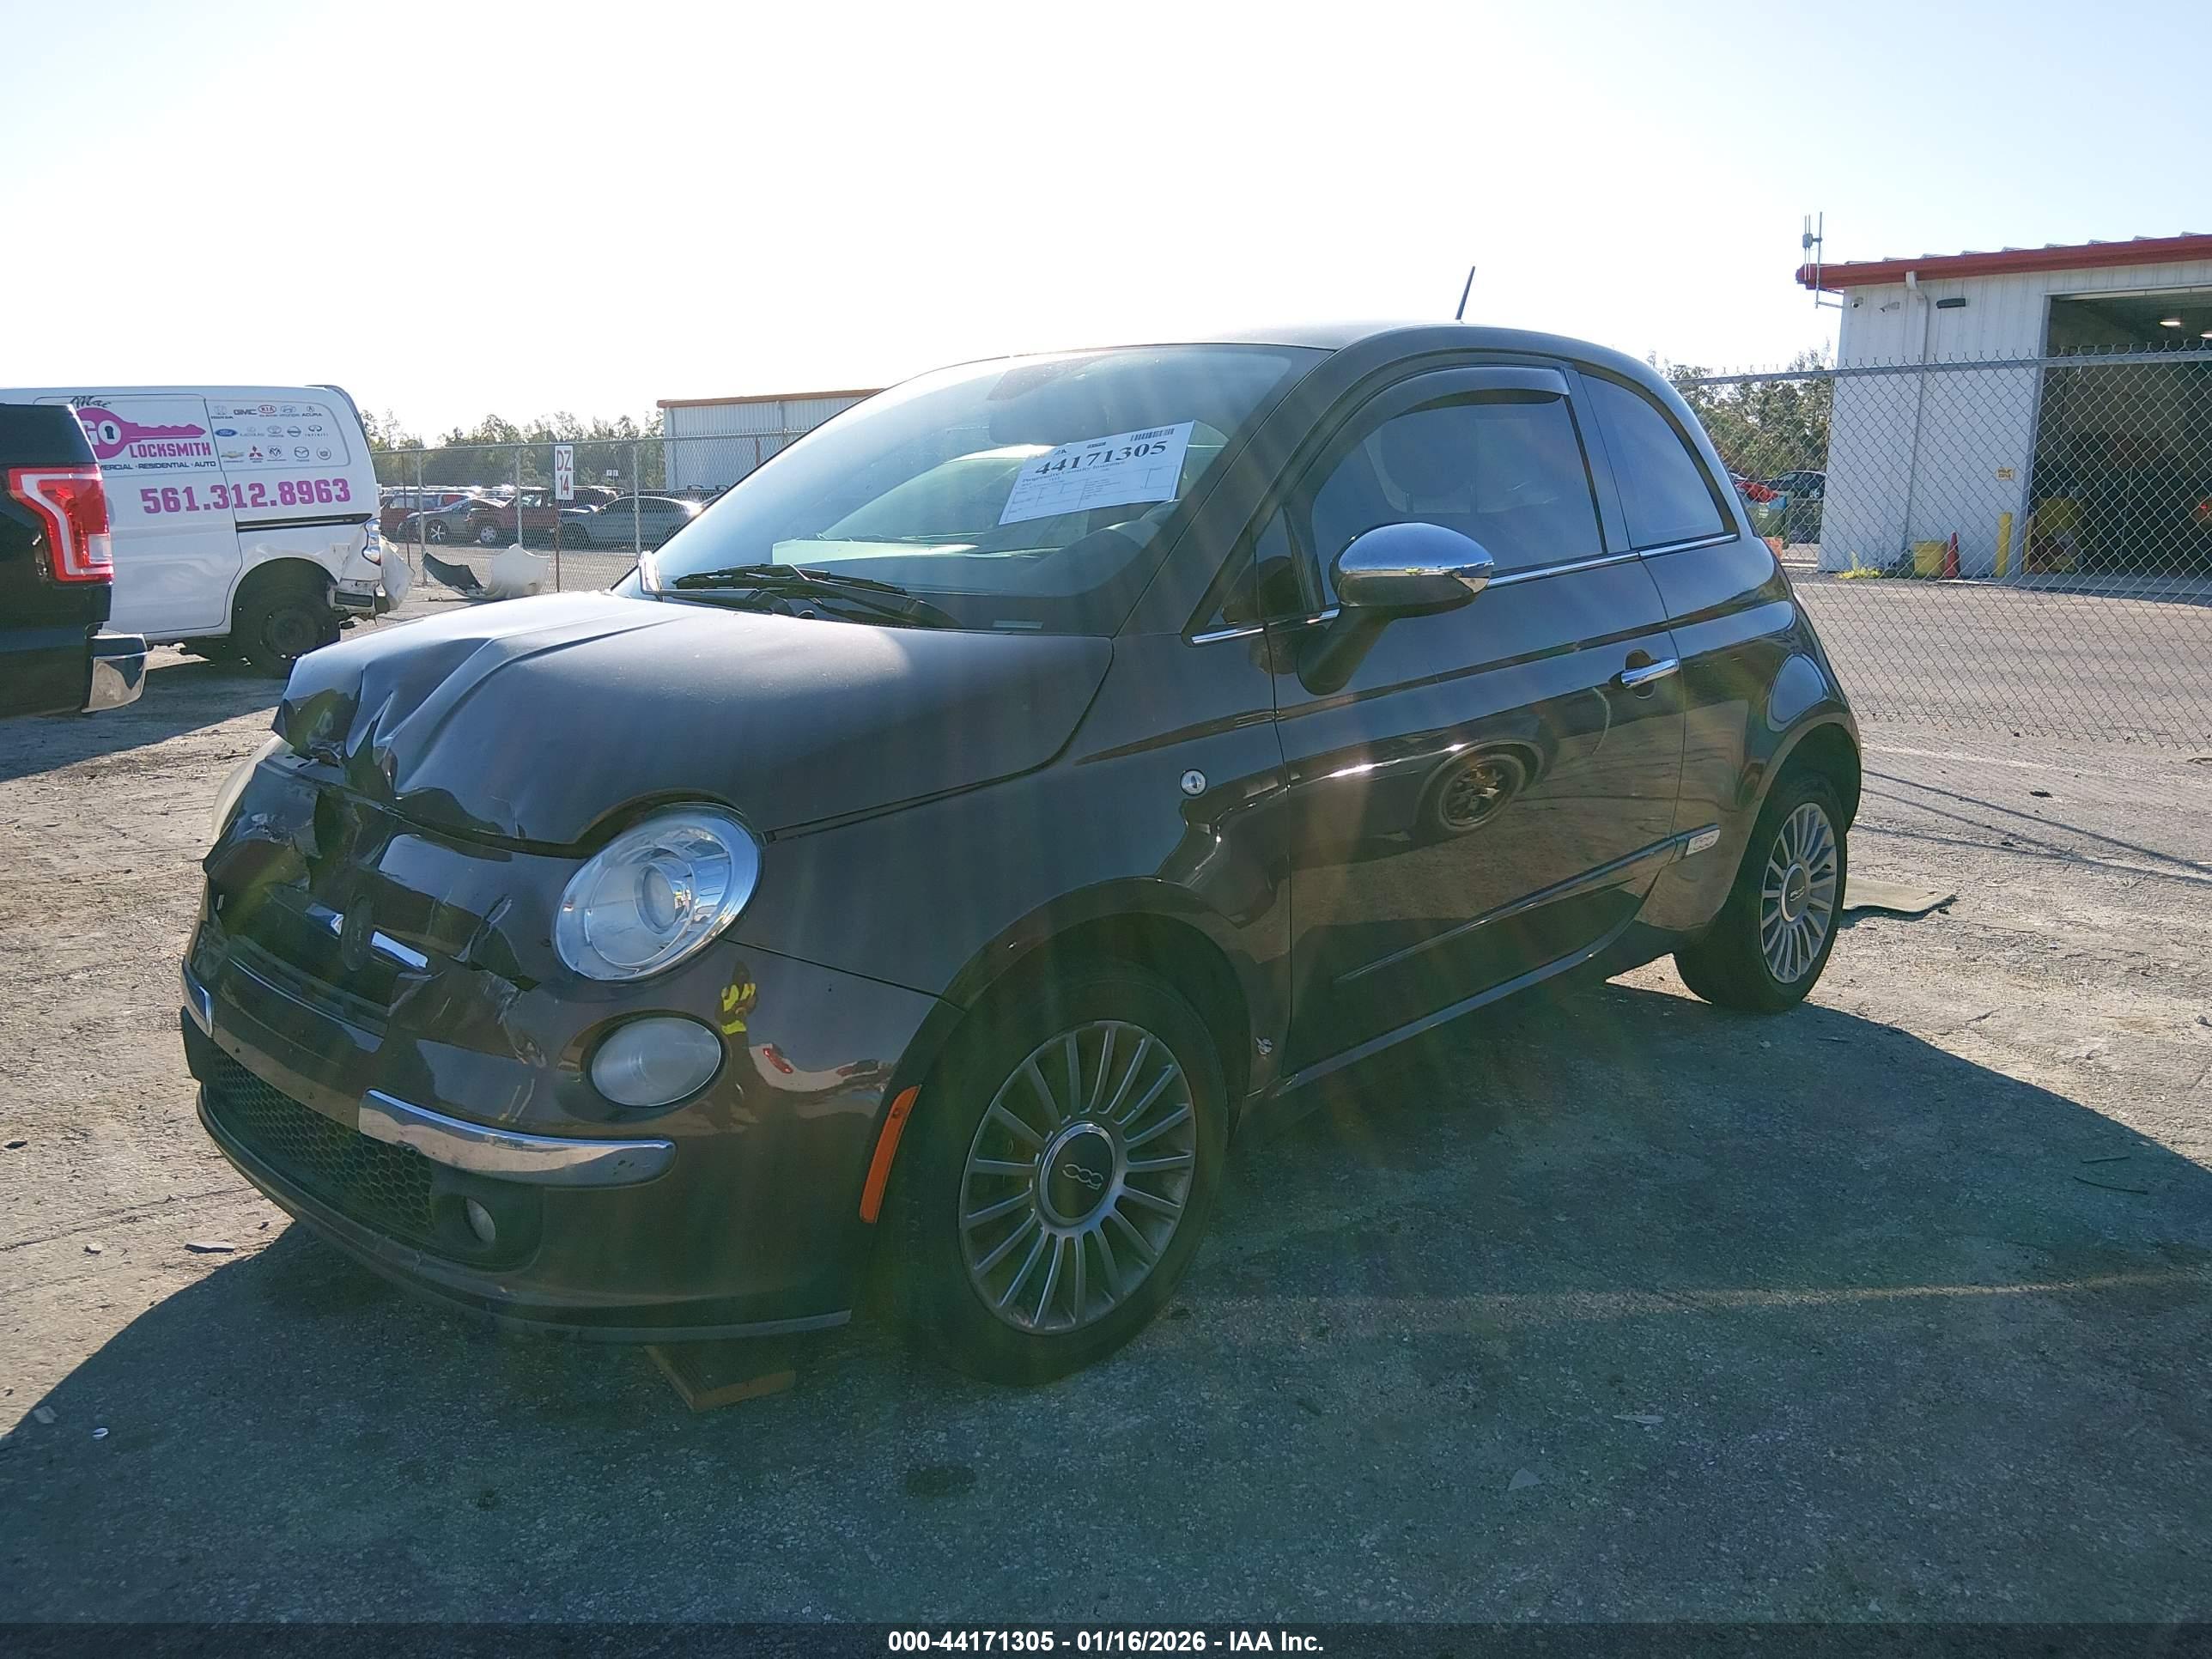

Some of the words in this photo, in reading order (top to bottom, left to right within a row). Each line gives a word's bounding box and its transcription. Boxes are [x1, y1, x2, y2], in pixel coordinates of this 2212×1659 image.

[128, 442, 211, 458] LOCKSMITH
[556, 449, 572, 471] DZ
[1035, 441, 1168, 474] 44171305
[138, 461, 190, 470] RESIDENTIAL
[559, 473, 570, 495] 14
[140, 477, 351, 514] 561.312.8963
